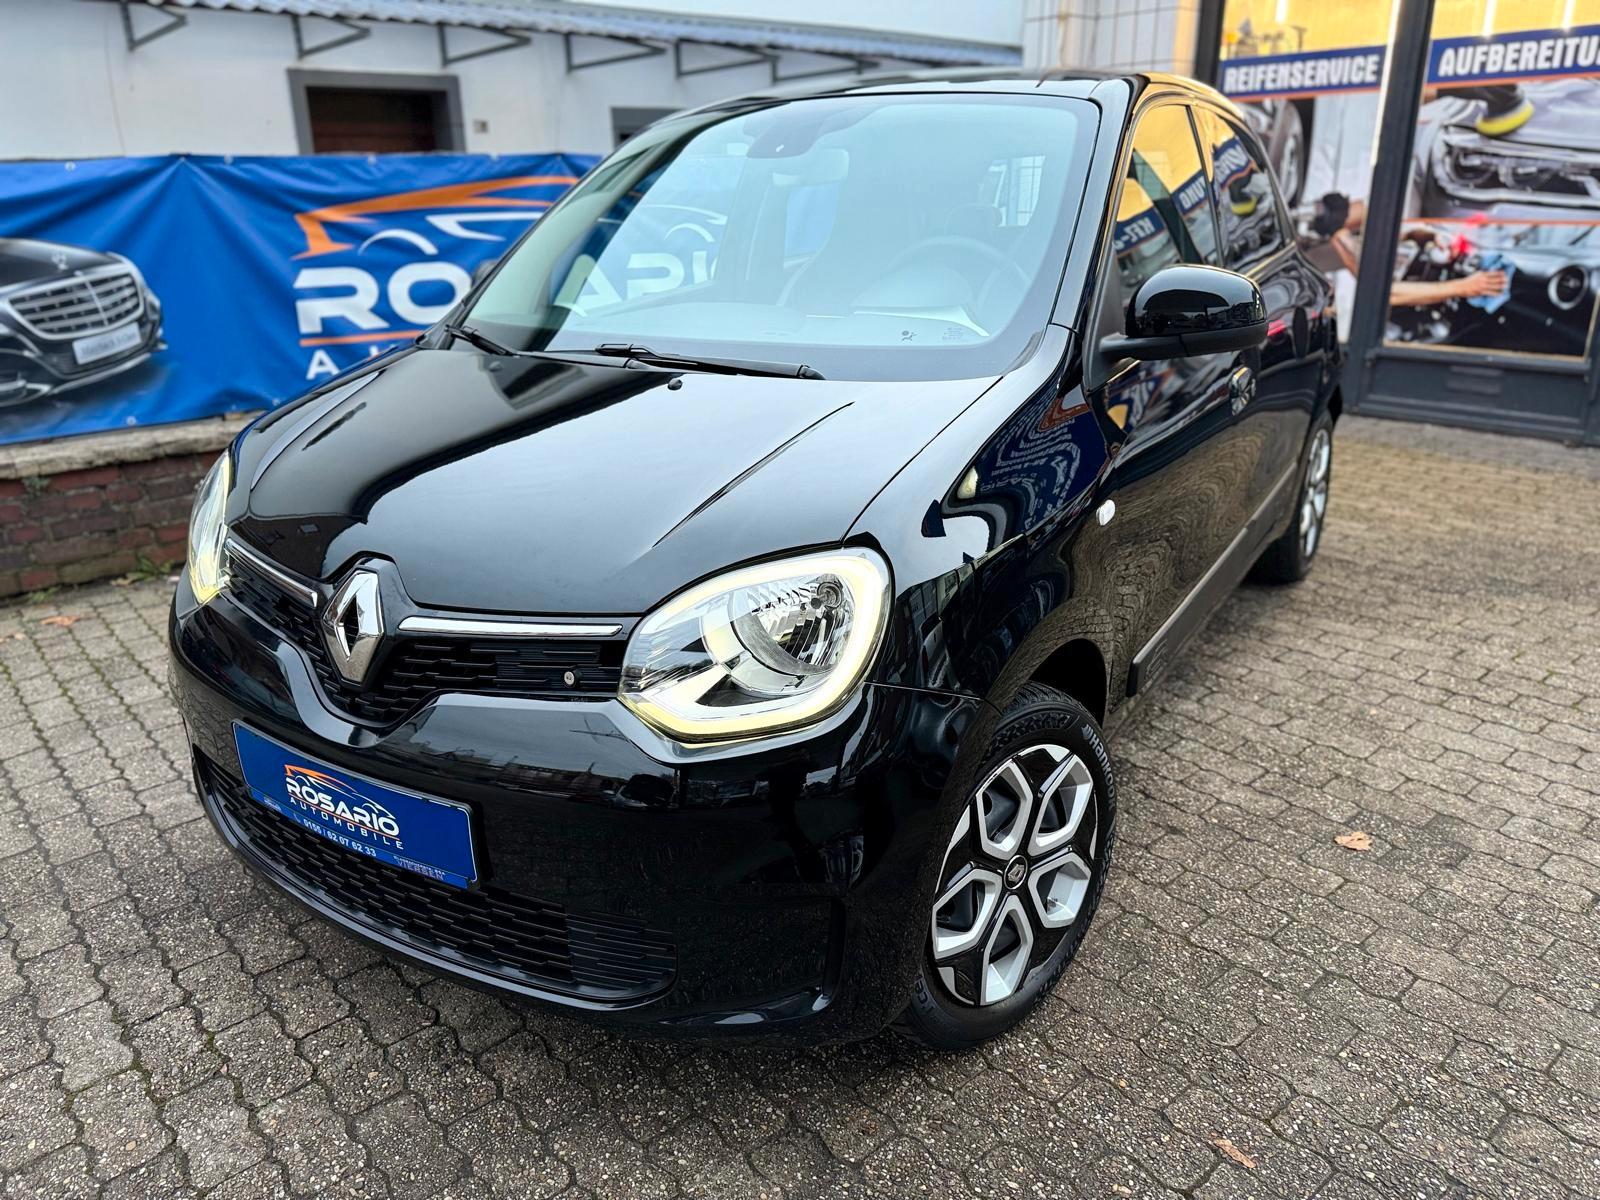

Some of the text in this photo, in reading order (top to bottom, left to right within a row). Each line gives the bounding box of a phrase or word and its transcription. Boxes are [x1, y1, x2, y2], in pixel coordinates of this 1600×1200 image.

[1223, 54, 1380, 93] REIFENSERVICE
[1437, 34, 1600, 77] AUFBEREITU
[285, 776, 400, 836] ROSARIO
[290, 796, 404, 850] AUTOMOBILE
[364, 846, 377, 857] 33
